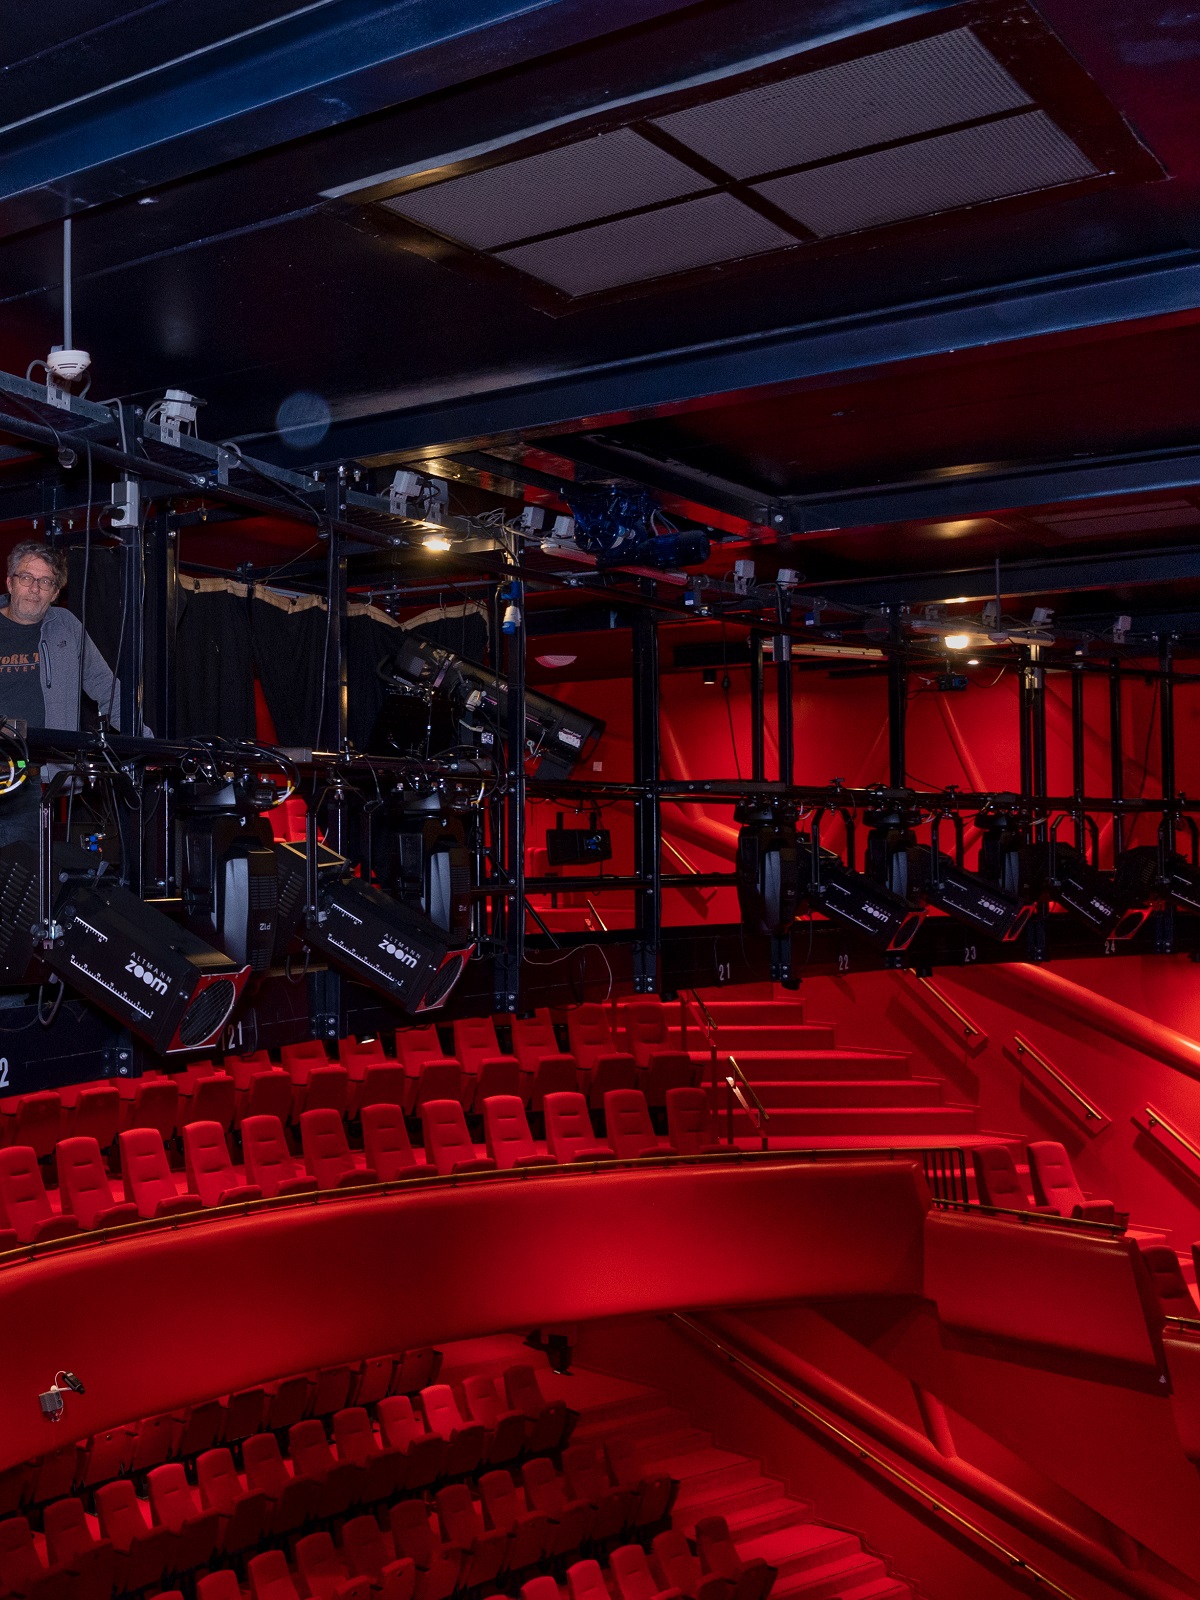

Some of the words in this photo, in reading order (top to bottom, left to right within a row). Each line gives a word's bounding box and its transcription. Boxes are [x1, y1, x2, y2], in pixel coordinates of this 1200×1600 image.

[861, 904, 889, 923] zoom
[977, 899, 1004, 916] zoom
[378, 939, 418, 969] zoom
[383, 933, 421, 959] ALTMANN
[964, 945, 976, 962] 23
[1104, 940, 1116, 954] 24
[131, 952, 172, 983] ALTMANN
[718, 962, 731, 981] 21
[838, 954, 849, 971] 22
[125, 959, 168, 995] zoom
